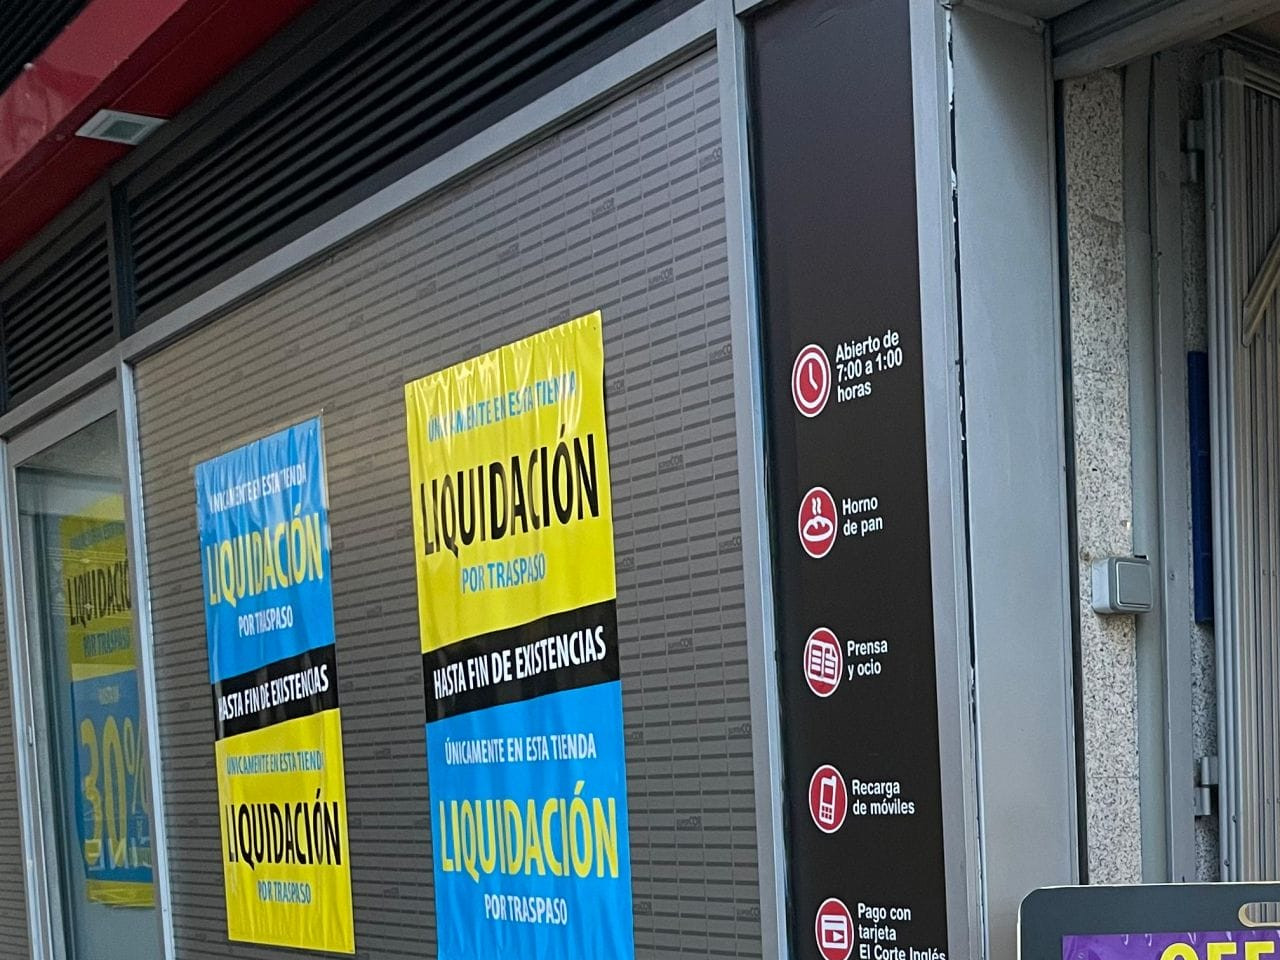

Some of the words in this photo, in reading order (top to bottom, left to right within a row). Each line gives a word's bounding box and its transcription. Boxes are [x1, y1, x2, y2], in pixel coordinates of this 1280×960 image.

[835, 336, 880, 363] Abierto
[883, 329, 899, 347] de
[836, 361, 862, 383] 7:00
[865, 358, 873, 375] a
[876, 347, 902, 372] 1:00
[837, 380, 872, 402] horas
[420, 424, 599, 558] LIQUIDACIÓN
[842, 497, 878, 516] Horno
[843, 519, 858, 536] de
[861, 516, 883, 539] pan
[206, 503, 323, 607] LIQUIDACIÓN
[462, 567, 485, 593] POR
[487, 553, 545, 589] TRASPASO
[67, 551, 131, 628] LIQUIDACIÓ
[239, 614, 254, 637] POR
[255, 605, 293, 633] TRASPASO
[433, 664, 466, 699] HASTA
[468, 655, 489, 691] FIN
[491, 650, 512, 682] DE
[516, 626, 606, 679] EXISTENCIAS
[847, 639, 888, 657] Prensa
[848, 662, 854, 680] y
[858, 658, 881, 676] ocio
[218, 692, 243, 721] HASTA
[244, 687, 259, 713] FIN
[259, 684, 270, 709] DE
[271, 664, 329, 706] EXISTENCIAS
[445, 737, 504, 765] ÚNICAMENTE
[507, 738, 523, 762] EN
[526, 736, 549, 761] ESTA
[551, 733, 596, 759] TIENDA
[852, 779, 900, 798] Recarga
[853, 799, 867, 815] de
[870, 796, 915, 815] móviles
[225, 788, 341, 870] LIQUIDACIÓN
[439, 780, 619, 883] LIQUIDACIÓN
[258, 880, 272, 901] POR
[274, 880, 311, 904] TRASPASO
[484, 894, 507, 920] POR
[508, 895, 568, 925] TRASPASO
[858, 903, 886, 925] Pago
[890, 904, 911, 921] con
[858, 923, 896, 943] tarjeta
[860, 943, 871, 960] El
